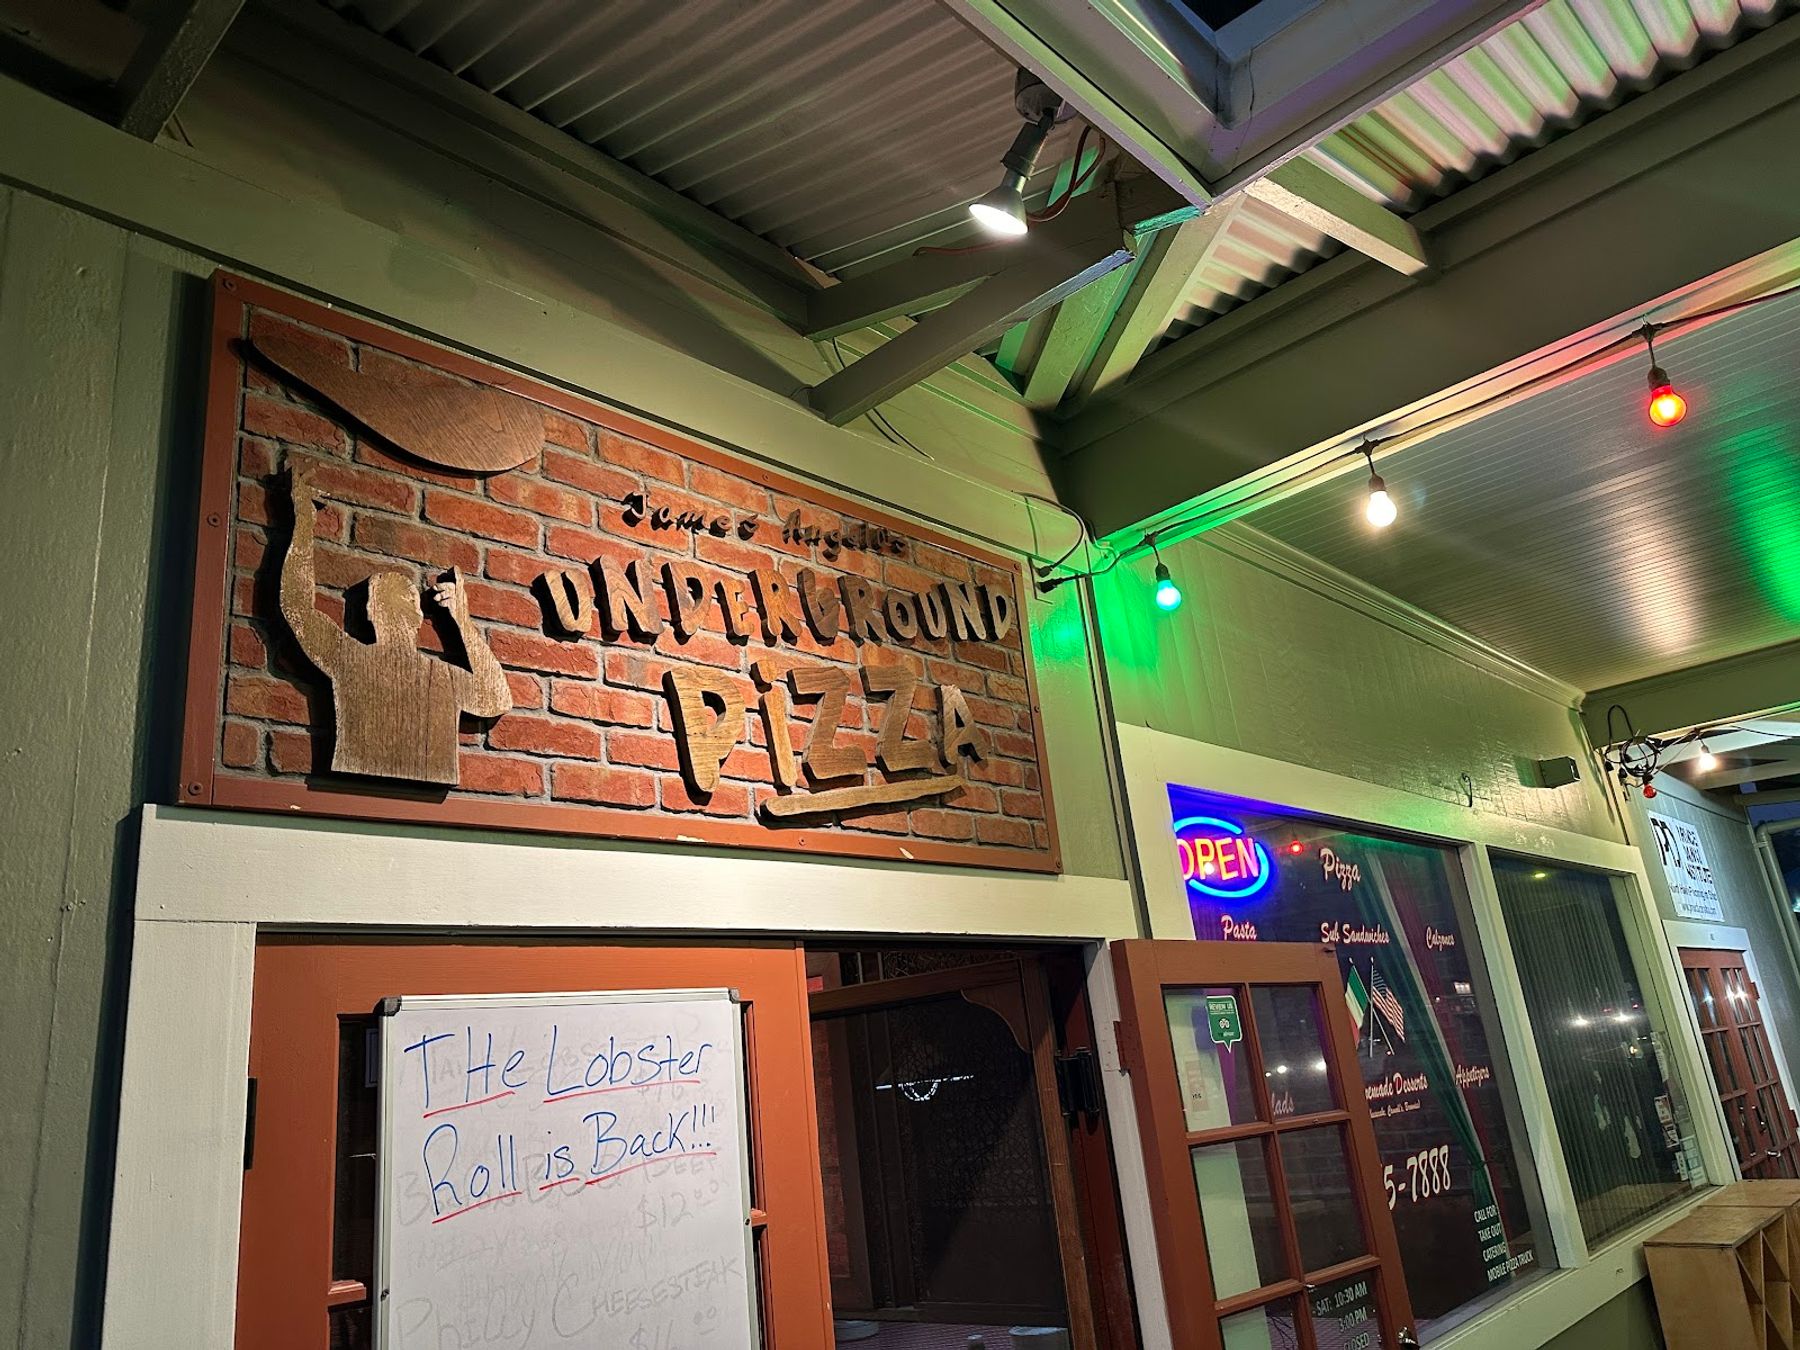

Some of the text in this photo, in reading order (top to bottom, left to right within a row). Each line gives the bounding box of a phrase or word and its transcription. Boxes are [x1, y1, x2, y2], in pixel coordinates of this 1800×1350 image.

[621, 492, 758, 540] James
[531, 554, 1014, 645] UNDERGROUND
[1176, 837, 1259, 881] OPEN
[1319, 847, 1361, 891] Pizza
[1220, 914, 1257, 941] Pasta
[1320, 921, 1390, 944] Sub Sandwiches
[1426, 926, 1455, 951] Calzones
[546, 1025, 713, 1096] Lobster
[1393, 1072, 1429, 1095] Desserts
[1456, 1064, 1490, 1088] Appetizers
[423, 1124, 516, 1216] Roll
[545, 1131, 574, 1180] is
[583, 1105, 717, 1175] Back!!!
[1381, 1144, 1451, 1210] 5-7888
[1474, 1204, 1498, 1222] CALL FOR
[1477, 1222, 1502, 1242] TAKE OUT
[1482, 1241, 1507, 1262] CATERING
[1487, 1249, 1534, 1281] MOBILE PIZZA TRUCK
[1316, 1281, 1368, 1316] SAT: 10:30 AM
[1339, 1306, 1368, 1332] 3:00 PM
